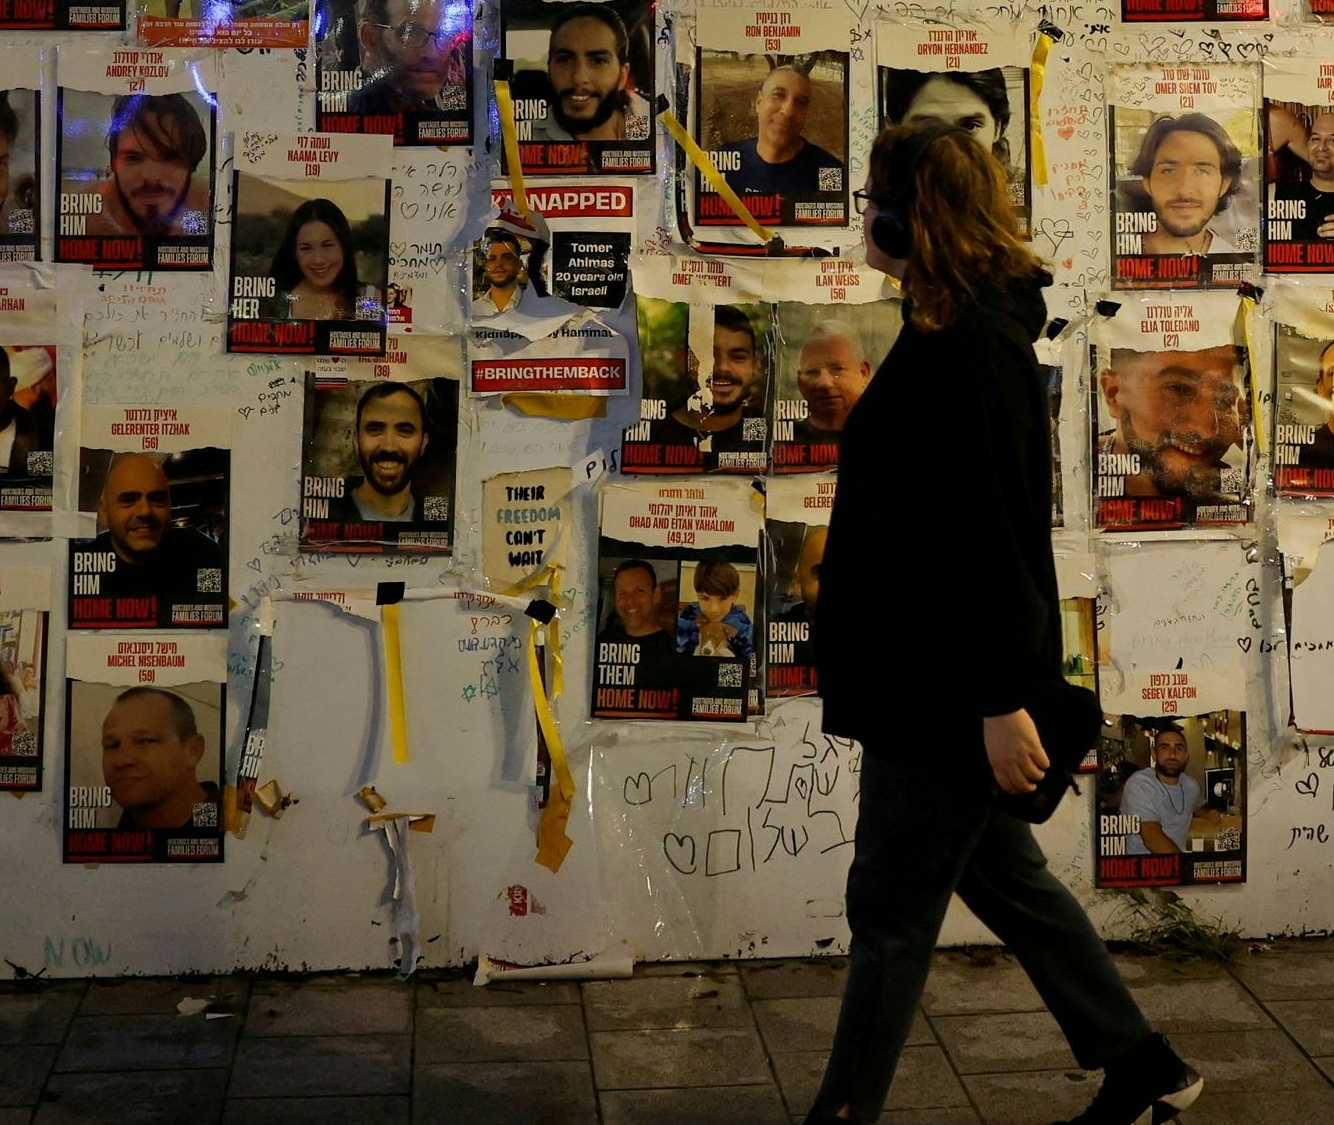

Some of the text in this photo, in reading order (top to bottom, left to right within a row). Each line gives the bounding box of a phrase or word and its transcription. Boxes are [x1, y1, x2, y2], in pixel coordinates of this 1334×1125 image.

[746, 26, 800, 37] RON BENJAMIN
[765, 38, 780, 51] (53)
[288, 150, 338, 162] NAAMA LEVY
[306, 163, 320, 177] (19)
[492, 192, 626, 211] KNAPPED
[571, 243, 613, 253] Tomer
[568, 257, 614, 268] Ahimas
[556, 272, 623, 283] 20 years old
[571, 286, 608, 296] Israeli
[475, 366, 620, 380] #BRINGTHEMBACK
[112, 423, 189, 435] GELERENTER ITZHAK
[142, 437, 158, 449] (56)
[506, 486, 545, 501] THEIR
[497, 507, 560, 524] FREEDOM
[630, 516, 734, 531] OHAD AND EITAN YAHALOMI
[506, 530, 545, 545] CAN'T
[667, 531, 695, 544] (49,12)
[509, 550, 543, 566] WAIT
[600, 643, 640, 664] BRING
[108, 655, 185, 667] MICHEL NISENBAUM
[139, 670, 155, 682] (59)
[598, 665, 635, 685] THEM
[597, 686, 678, 710] HOME NOW!
[1142, 687, 1196, 699] SEGEV KALFON
[1162, 701, 1177, 713] (25)
[70, 787, 111, 807] BRING
[69, 809, 96, 828] HIM
